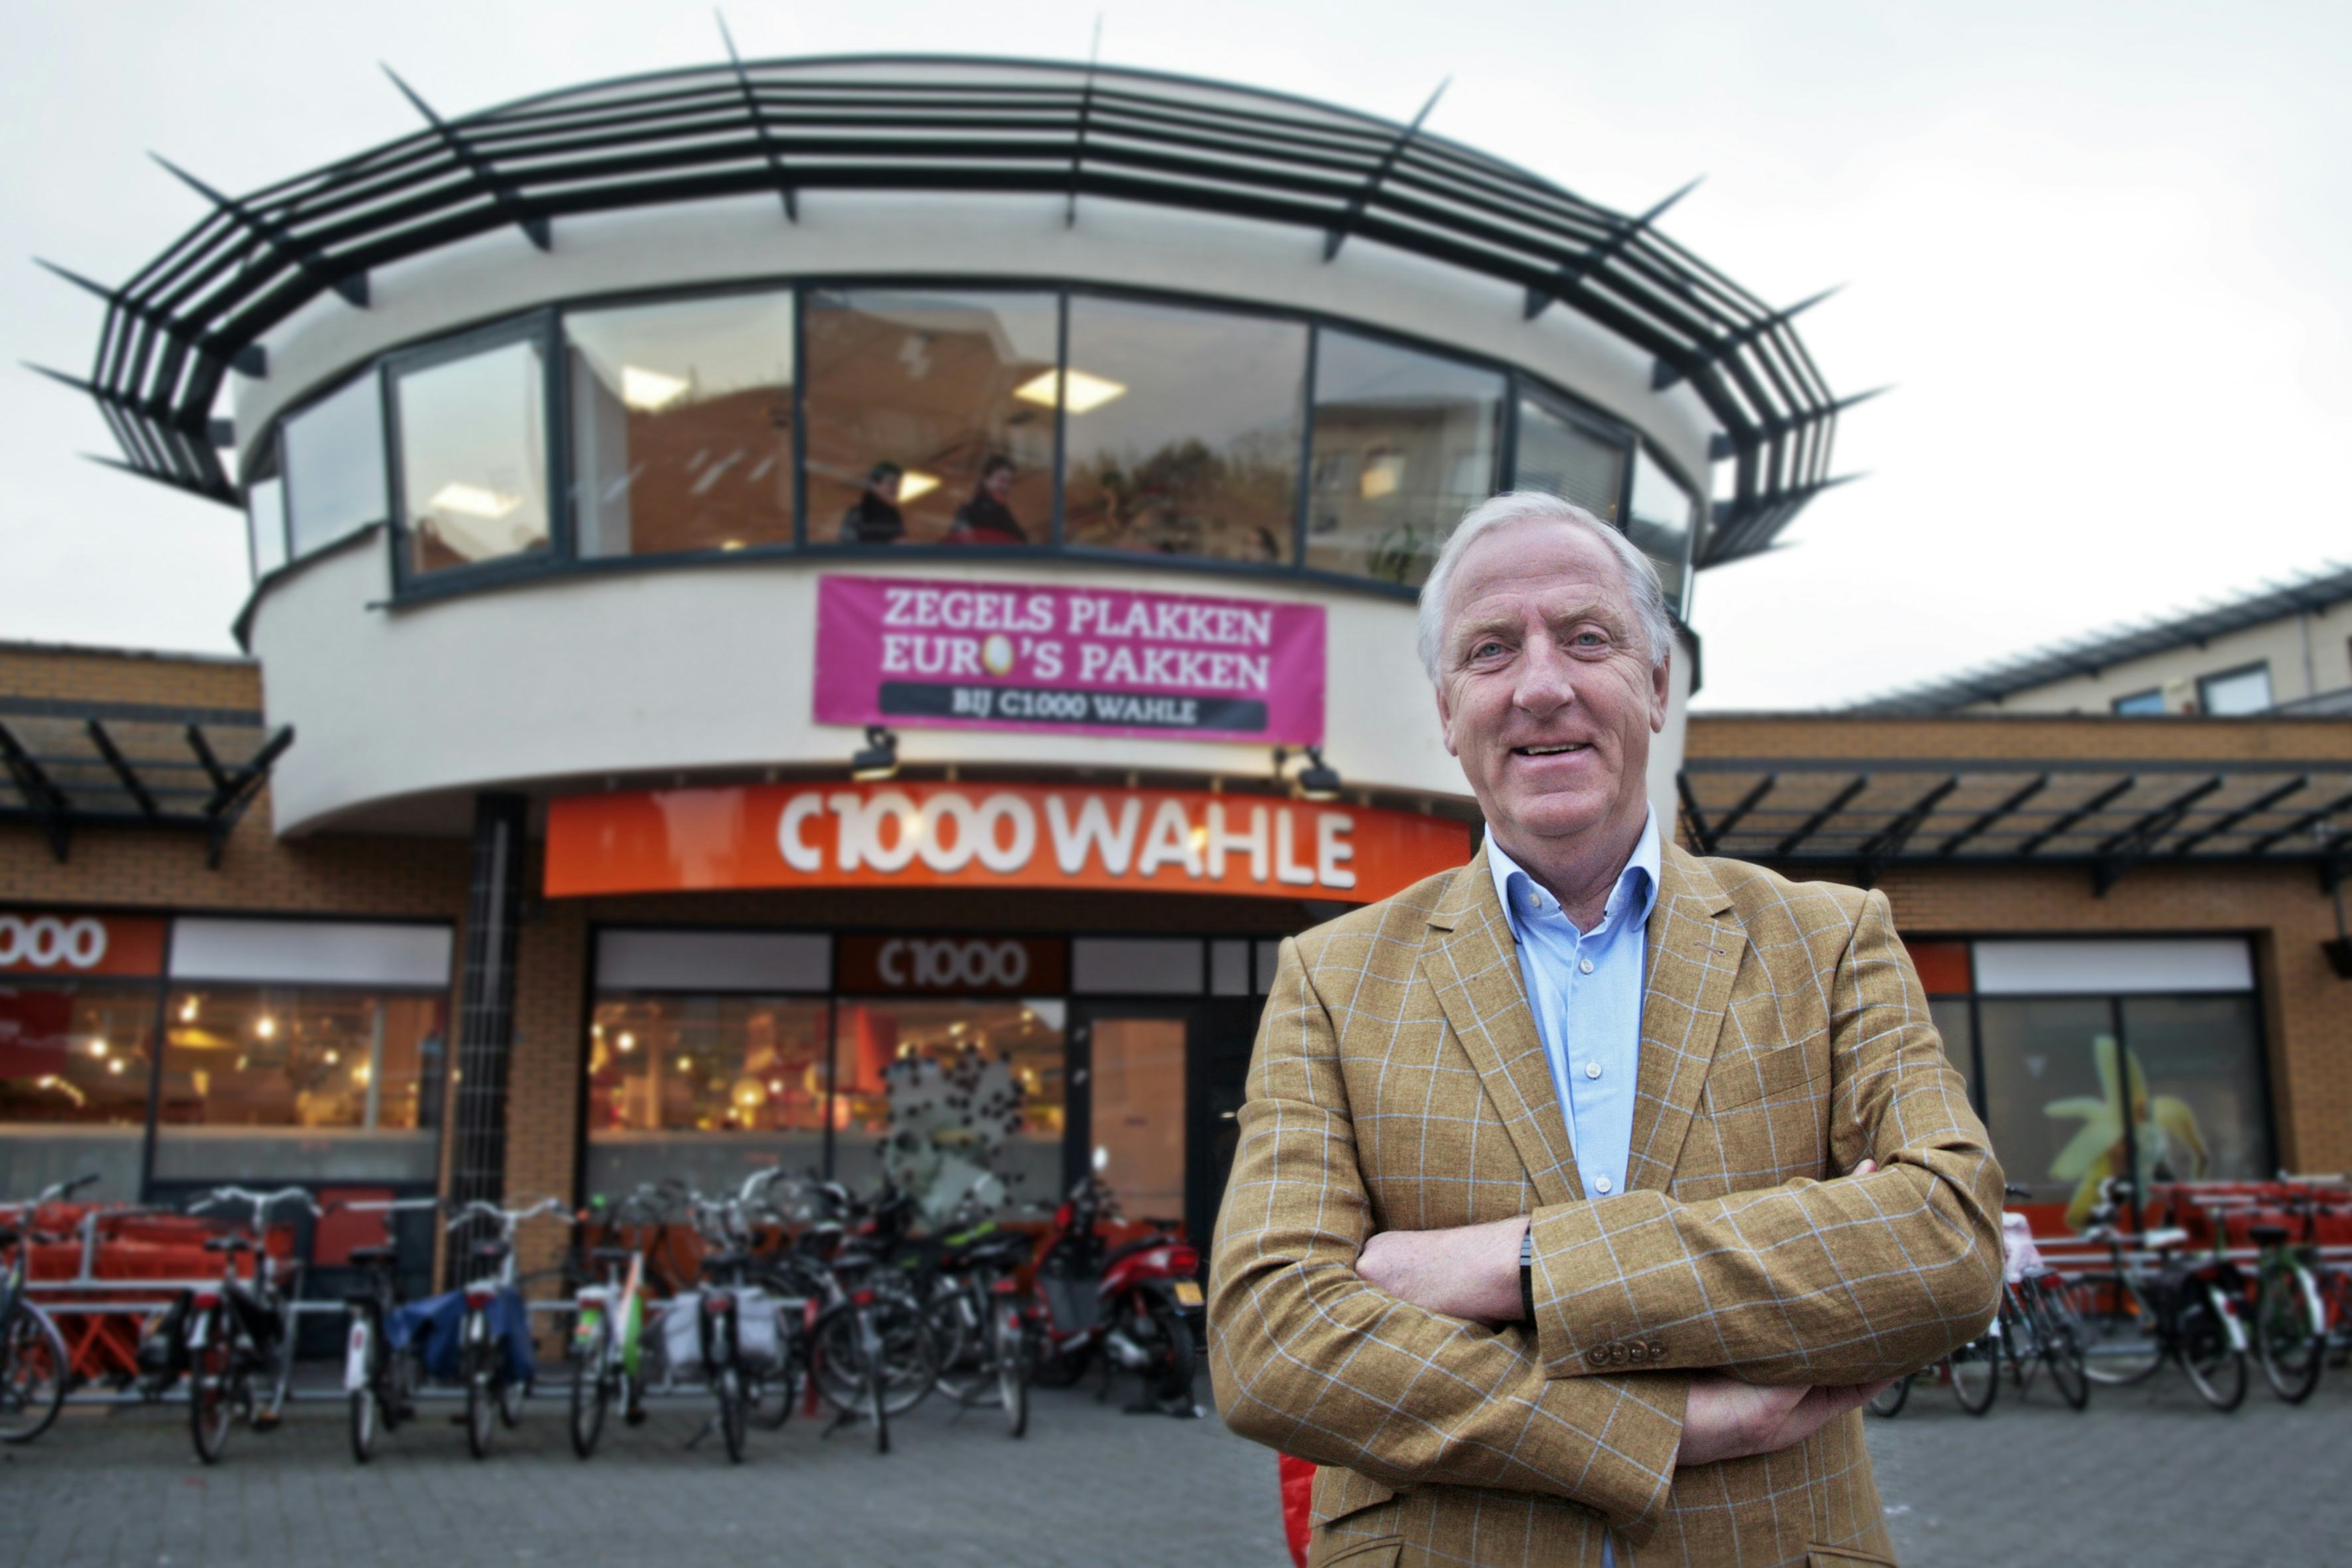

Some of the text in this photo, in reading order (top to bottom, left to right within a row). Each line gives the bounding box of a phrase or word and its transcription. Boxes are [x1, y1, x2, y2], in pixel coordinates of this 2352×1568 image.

[883, 587, 1273, 647] ZEGELS PLAKKEN
[1079, 644, 1270, 692] PAKKEN
[951, 688, 1198, 725] BIJ C1000 WAHLE
[778, 793, 1356, 889] C1000 WAHLE
[878, 939, 1028, 986] C1000
